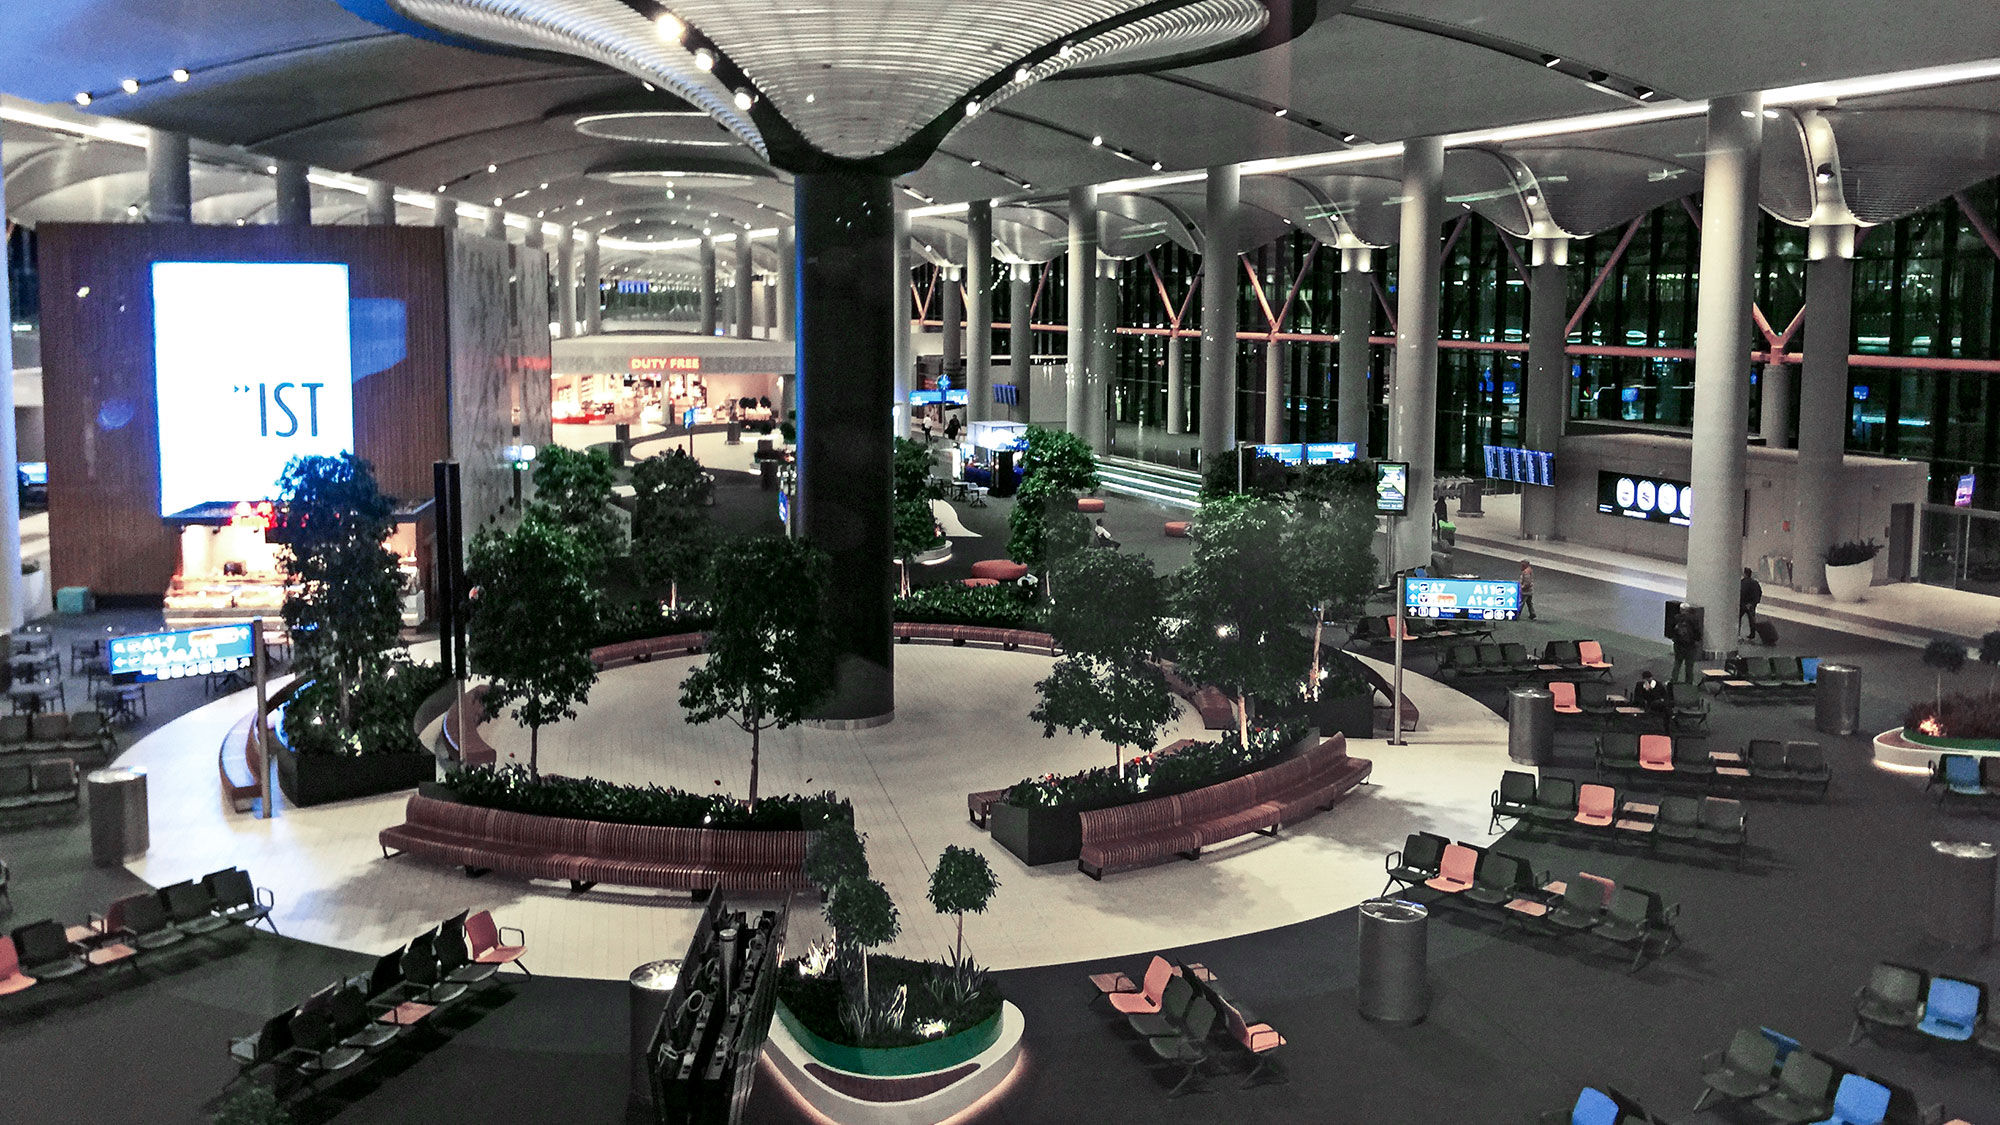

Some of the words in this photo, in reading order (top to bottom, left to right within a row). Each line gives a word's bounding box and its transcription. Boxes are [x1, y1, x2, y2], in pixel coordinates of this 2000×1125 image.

[631, 358, 667, 369] DUTY
[669, 358, 700, 369] FREE
[259, 382, 325, 437] IST
